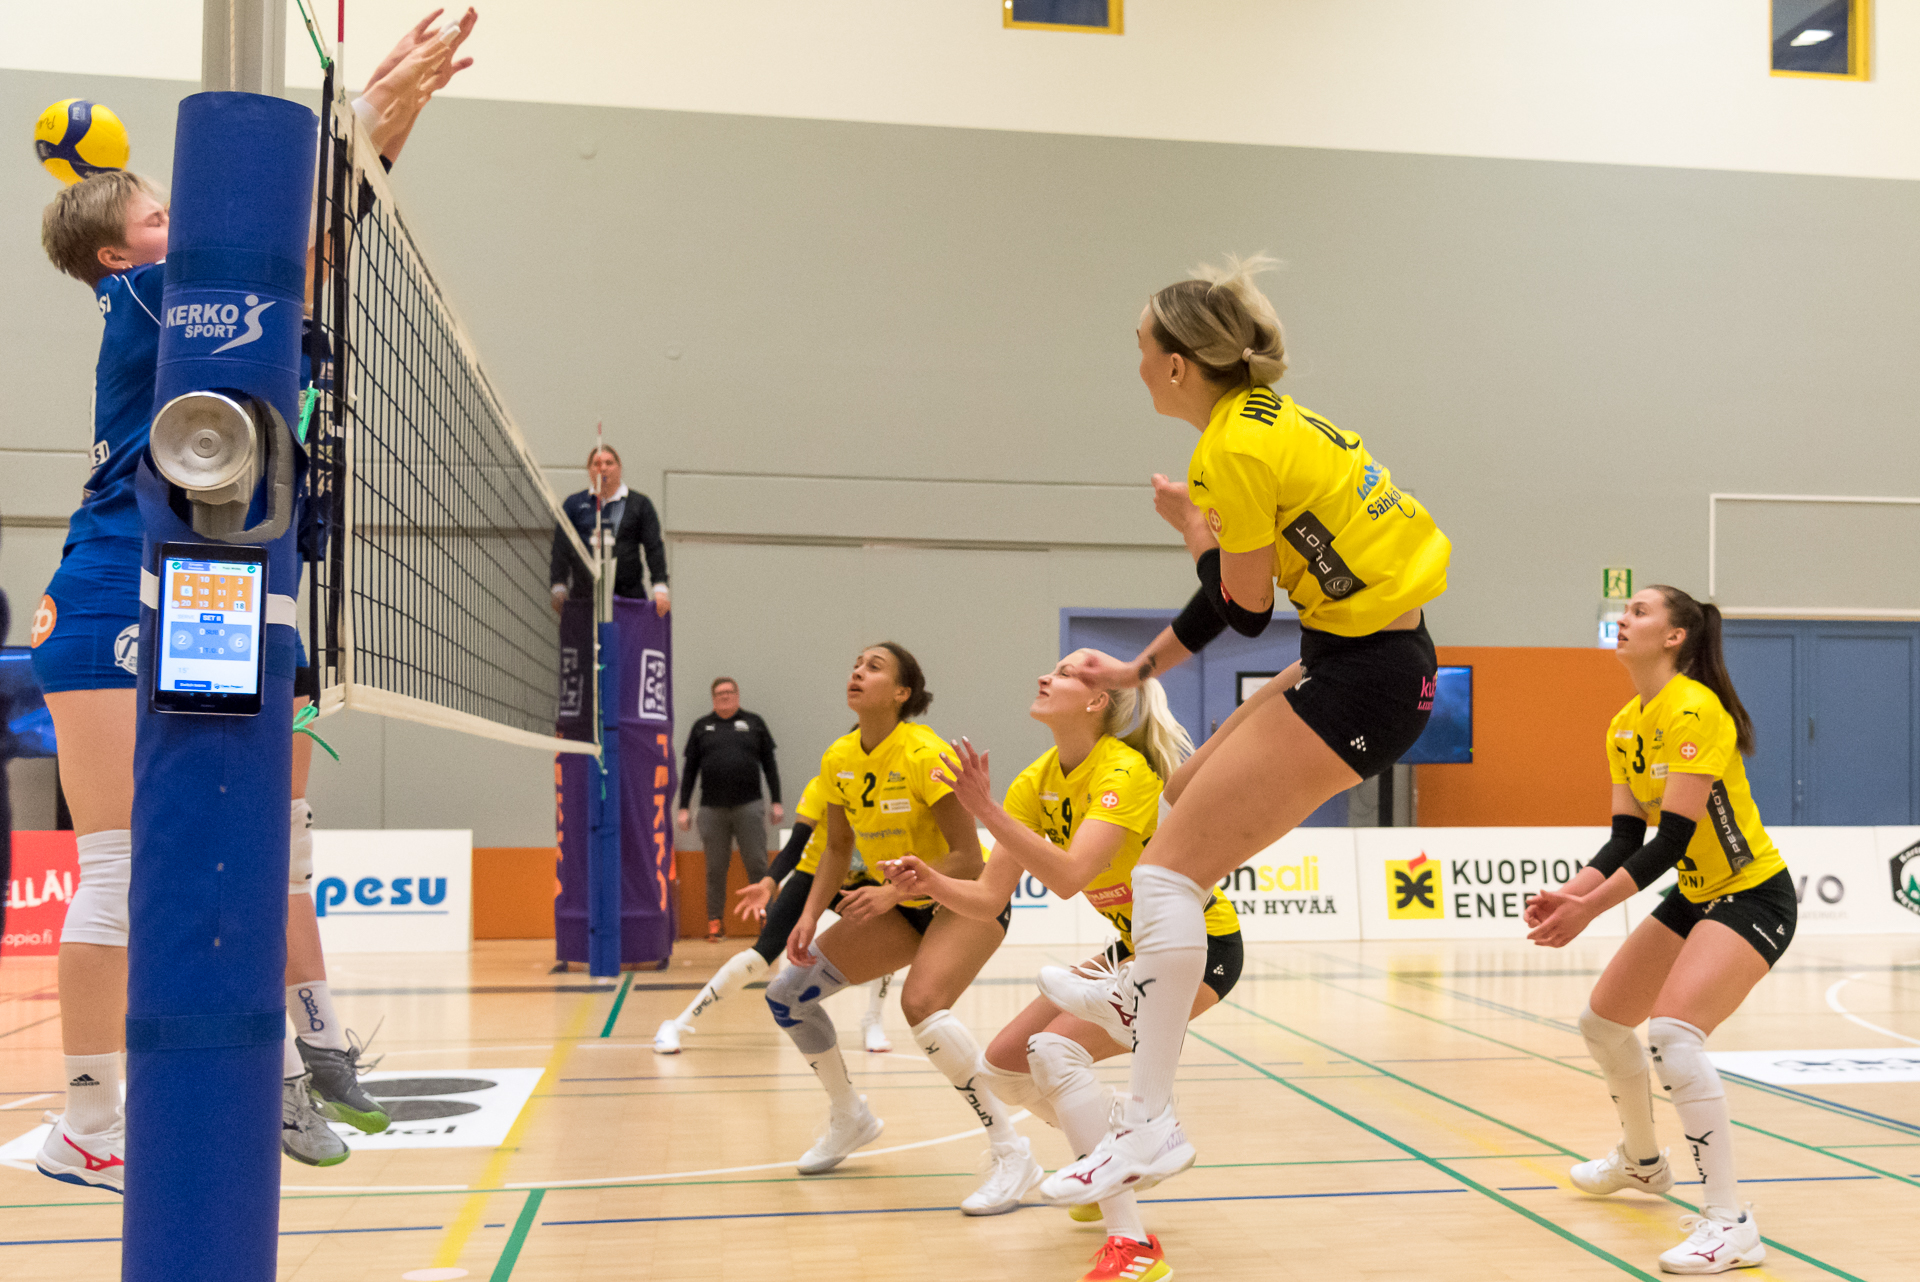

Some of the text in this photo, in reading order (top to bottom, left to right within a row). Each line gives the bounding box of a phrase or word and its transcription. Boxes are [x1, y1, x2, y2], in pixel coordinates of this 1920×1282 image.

[166, 303, 240, 328] KERKO
[184, 324, 237, 338] SPORT
[178, 635, 187, 645] 2
[235, 638, 244, 648] 6
[1632, 734, 1646, 774] 3
[861, 772, 876, 808] 2
[1062, 797, 1073, 839] 9
[315, 876, 447, 917] pesu
[1264, 895, 1337, 915] HYVÄÄ
